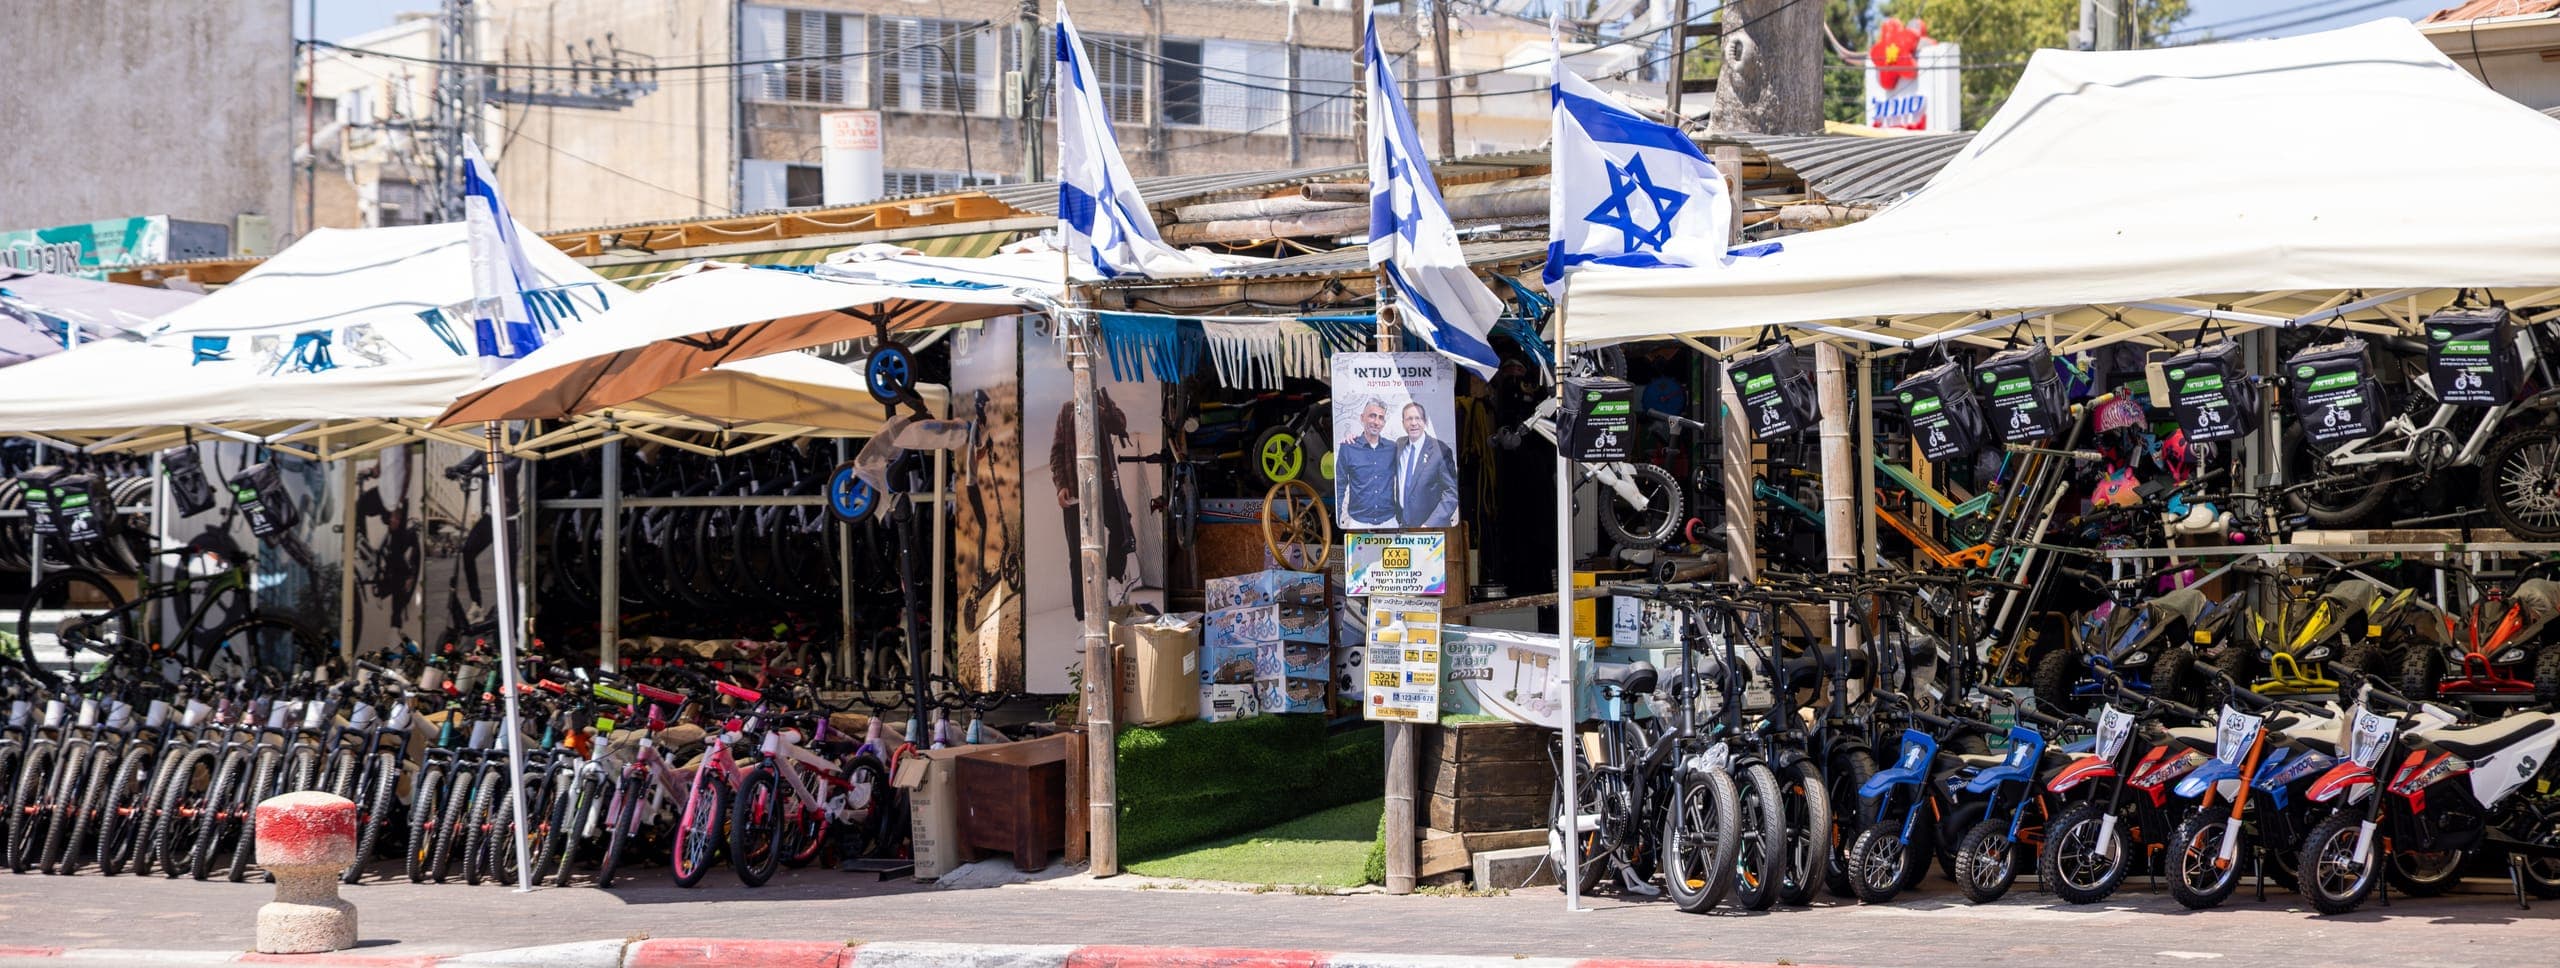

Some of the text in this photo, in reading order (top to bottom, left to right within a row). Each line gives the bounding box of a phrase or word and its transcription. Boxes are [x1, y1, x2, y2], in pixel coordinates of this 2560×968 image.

[1872, 96, 1924, 118] סונול
[1354, 366, 1432, 378] אופני עודאי
[1364, 537, 1393, 545] מחכים
[1394, 536, 1415, 545] אתם
[1417, 536, 1436, 545] למה
[1384, 558, 1409, 567] 0000
[1371, 569, 1394, 577] להזמין
[2292, 577, 2314, 586] XTR
[1374, 672, 1390, 680] כלב
[1373, 679, 1396, 687] בחצר
[2103, 711, 2119, 729] 43
[2227, 712, 2246, 732] 43
[2360, 714, 2380, 733] 43
[2516, 755, 2538, 779] 43
